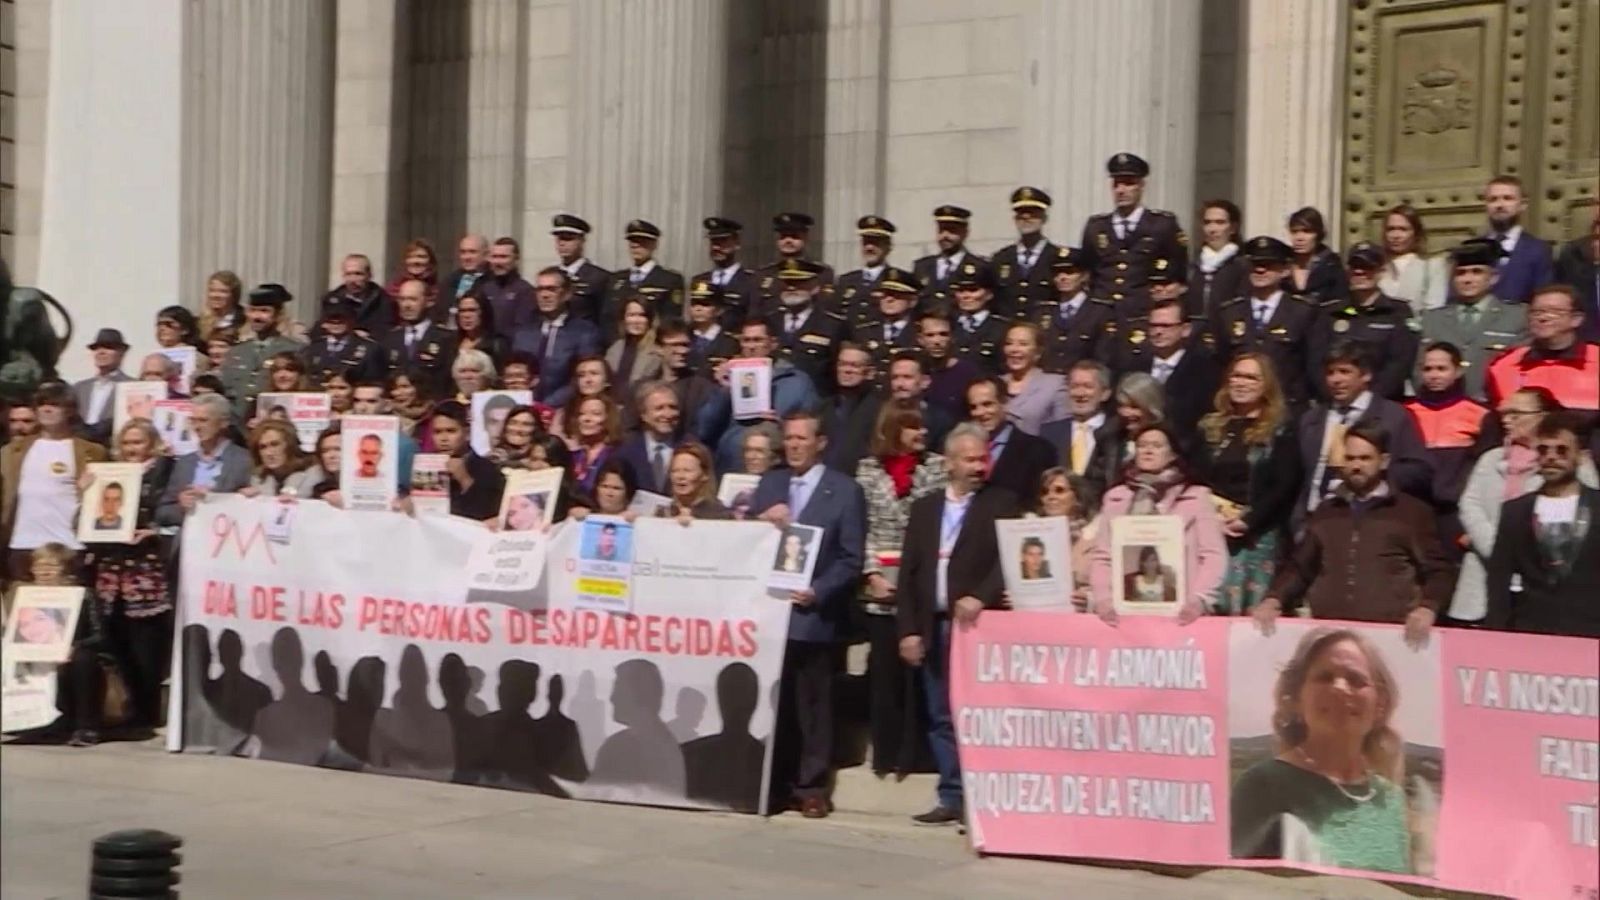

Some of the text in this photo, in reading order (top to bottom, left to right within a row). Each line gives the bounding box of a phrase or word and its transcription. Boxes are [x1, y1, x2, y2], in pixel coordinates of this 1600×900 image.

[252, 586, 286, 622] DE
[298, 592, 345, 629] LAS
[359, 597, 492, 644] PERSONAS
[507, 609, 758, 658] DESAPARECIDAS
[978, 637, 1207, 690] LA PAZ Y LA ARMONÍA
[1457, 668, 1478, 704] Y
[1482, 670, 1502, 708] A
[958, 706, 1216, 757] CONSTITUYEN LA MAYOR
[1061, 775, 1090, 815] DE
[1095, 777, 1123, 817] LA
[1127, 779, 1216, 823] FAMILIA
